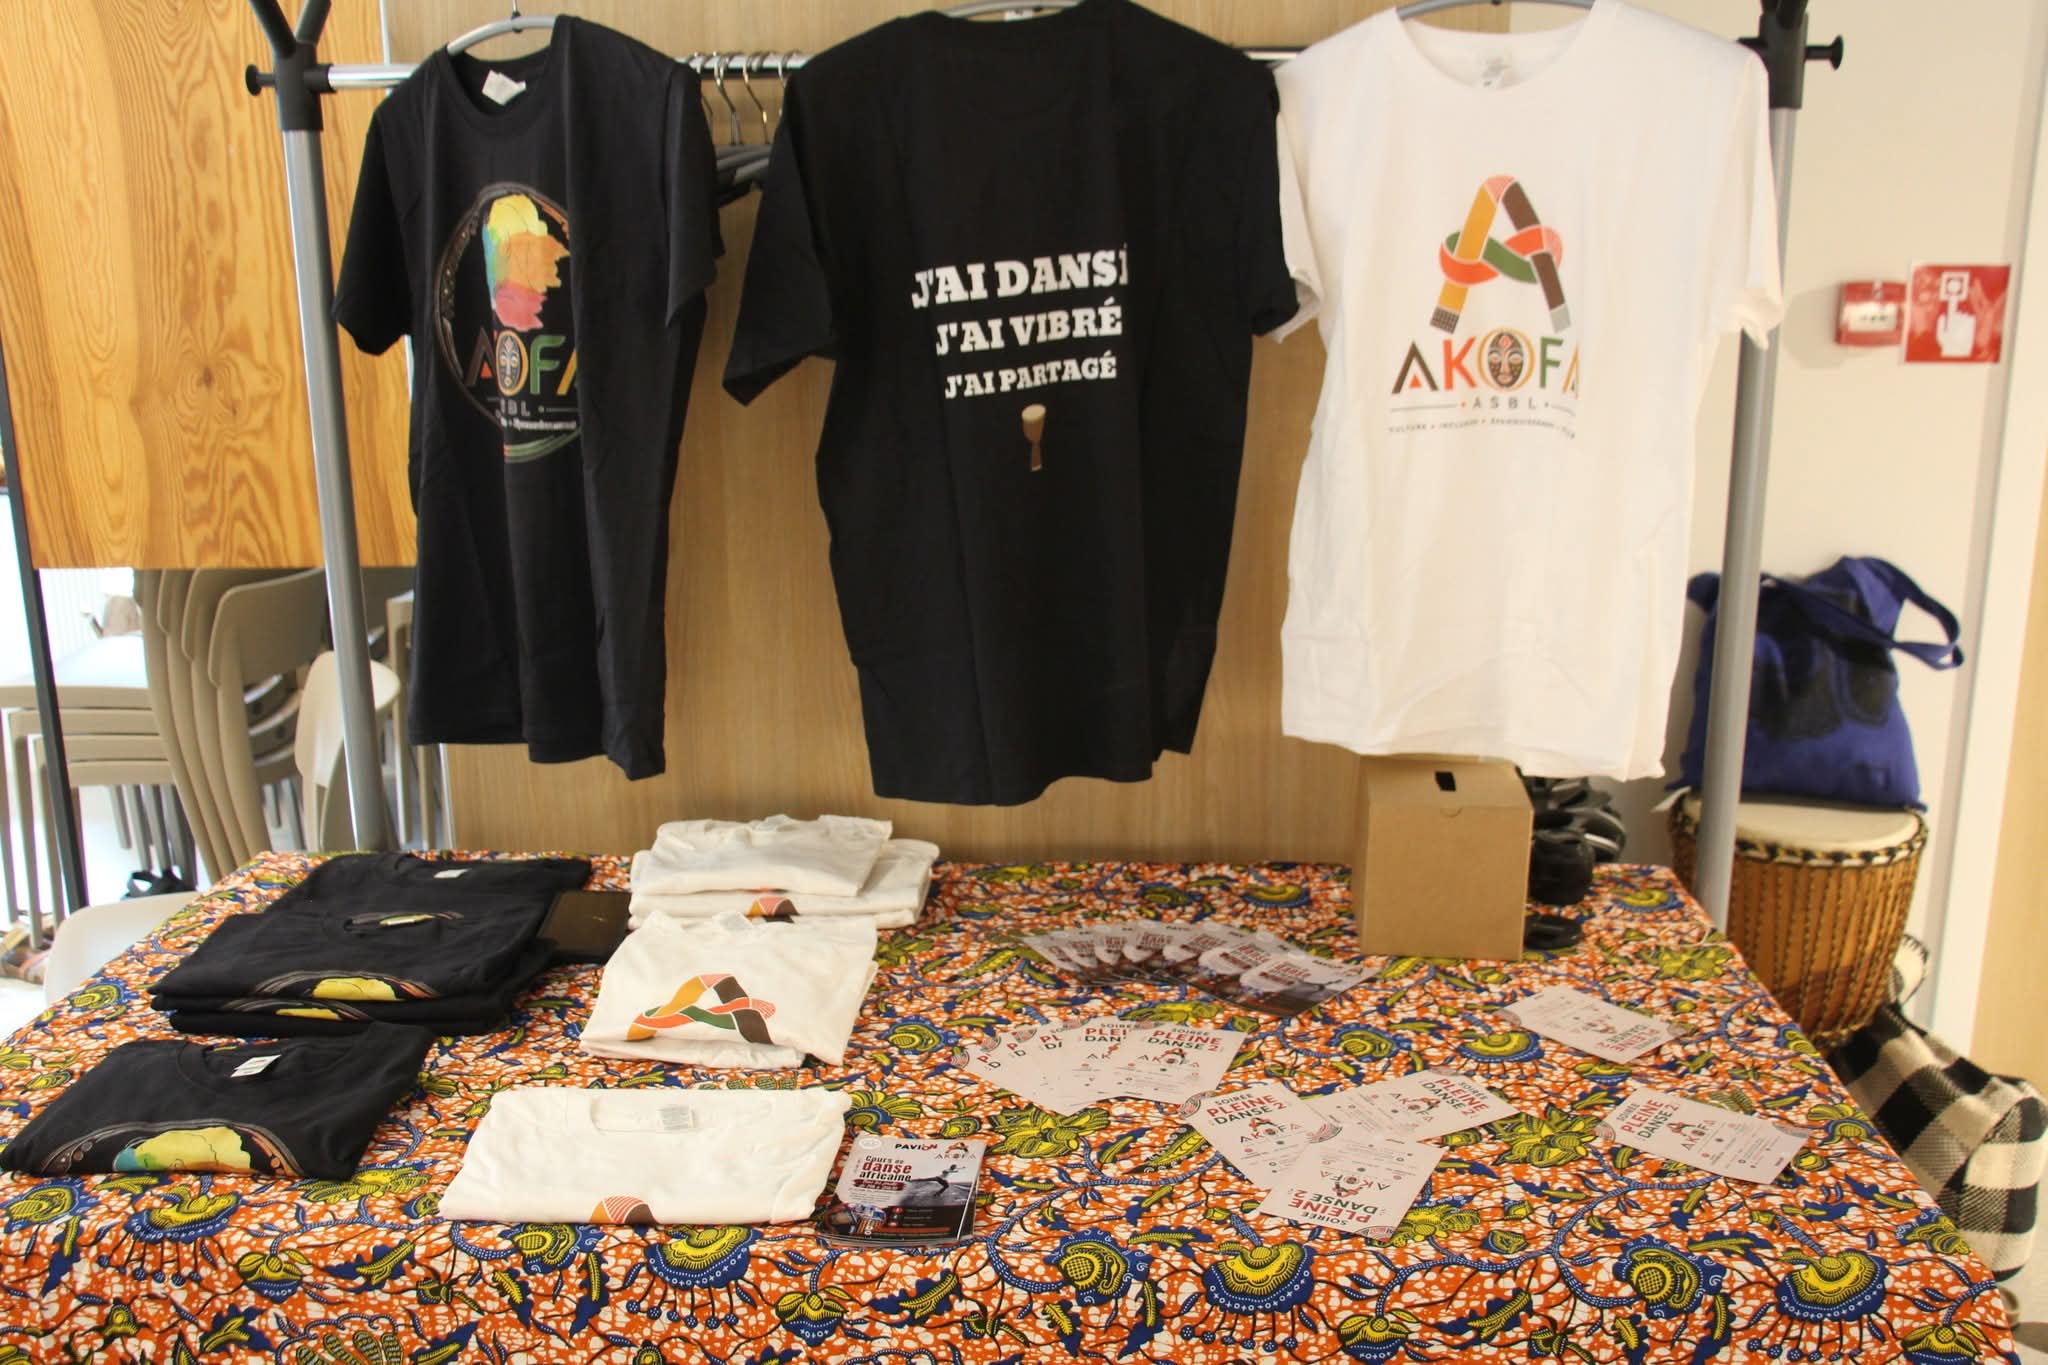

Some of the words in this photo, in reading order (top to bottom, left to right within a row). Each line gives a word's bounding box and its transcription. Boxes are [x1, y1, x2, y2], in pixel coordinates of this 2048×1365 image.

[911, 262, 989, 309] J'AI
[936, 317, 1005, 356] J'AI
[1009, 296, 1123, 347] VIBRÉ
[464, 327, 577, 397] AOF
[945, 371, 995, 400] J'AI
[999, 350, 1117, 392] PARTAGÉ
[1472, 397, 1537, 410] ASBL
[1084, 1027, 1132, 1036] PLEI
[1152, 1030, 1223, 1045] PLEINE
[1147, 1037, 1206, 1050] DANSE
[1207, 1044, 1219, 1052] 2
[1207, 1094, 1277, 1117] PLEINE
[1421, 1081, 1466, 1110] DANSE
[1435, 1077, 1489, 1112] PLEINE
[1213, 1105, 1273, 1125] DANSE
[1273, 1101, 1287, 1110] 2
[1621, 1099, 1664, 1133] PLEINE
[1637, 1109, 1673, 1139] DANSE
[1665, 1103, 1680, 1112] 2
[859, 1170, 912, 1182] africaine
[862, 1160, 912, 1174] danse
[1293, 1189, 1308, 1198] 2
[1310, 1193, 1378, 1215] DANSE
[1288, 1197, 1372, 1224] PLEINE
